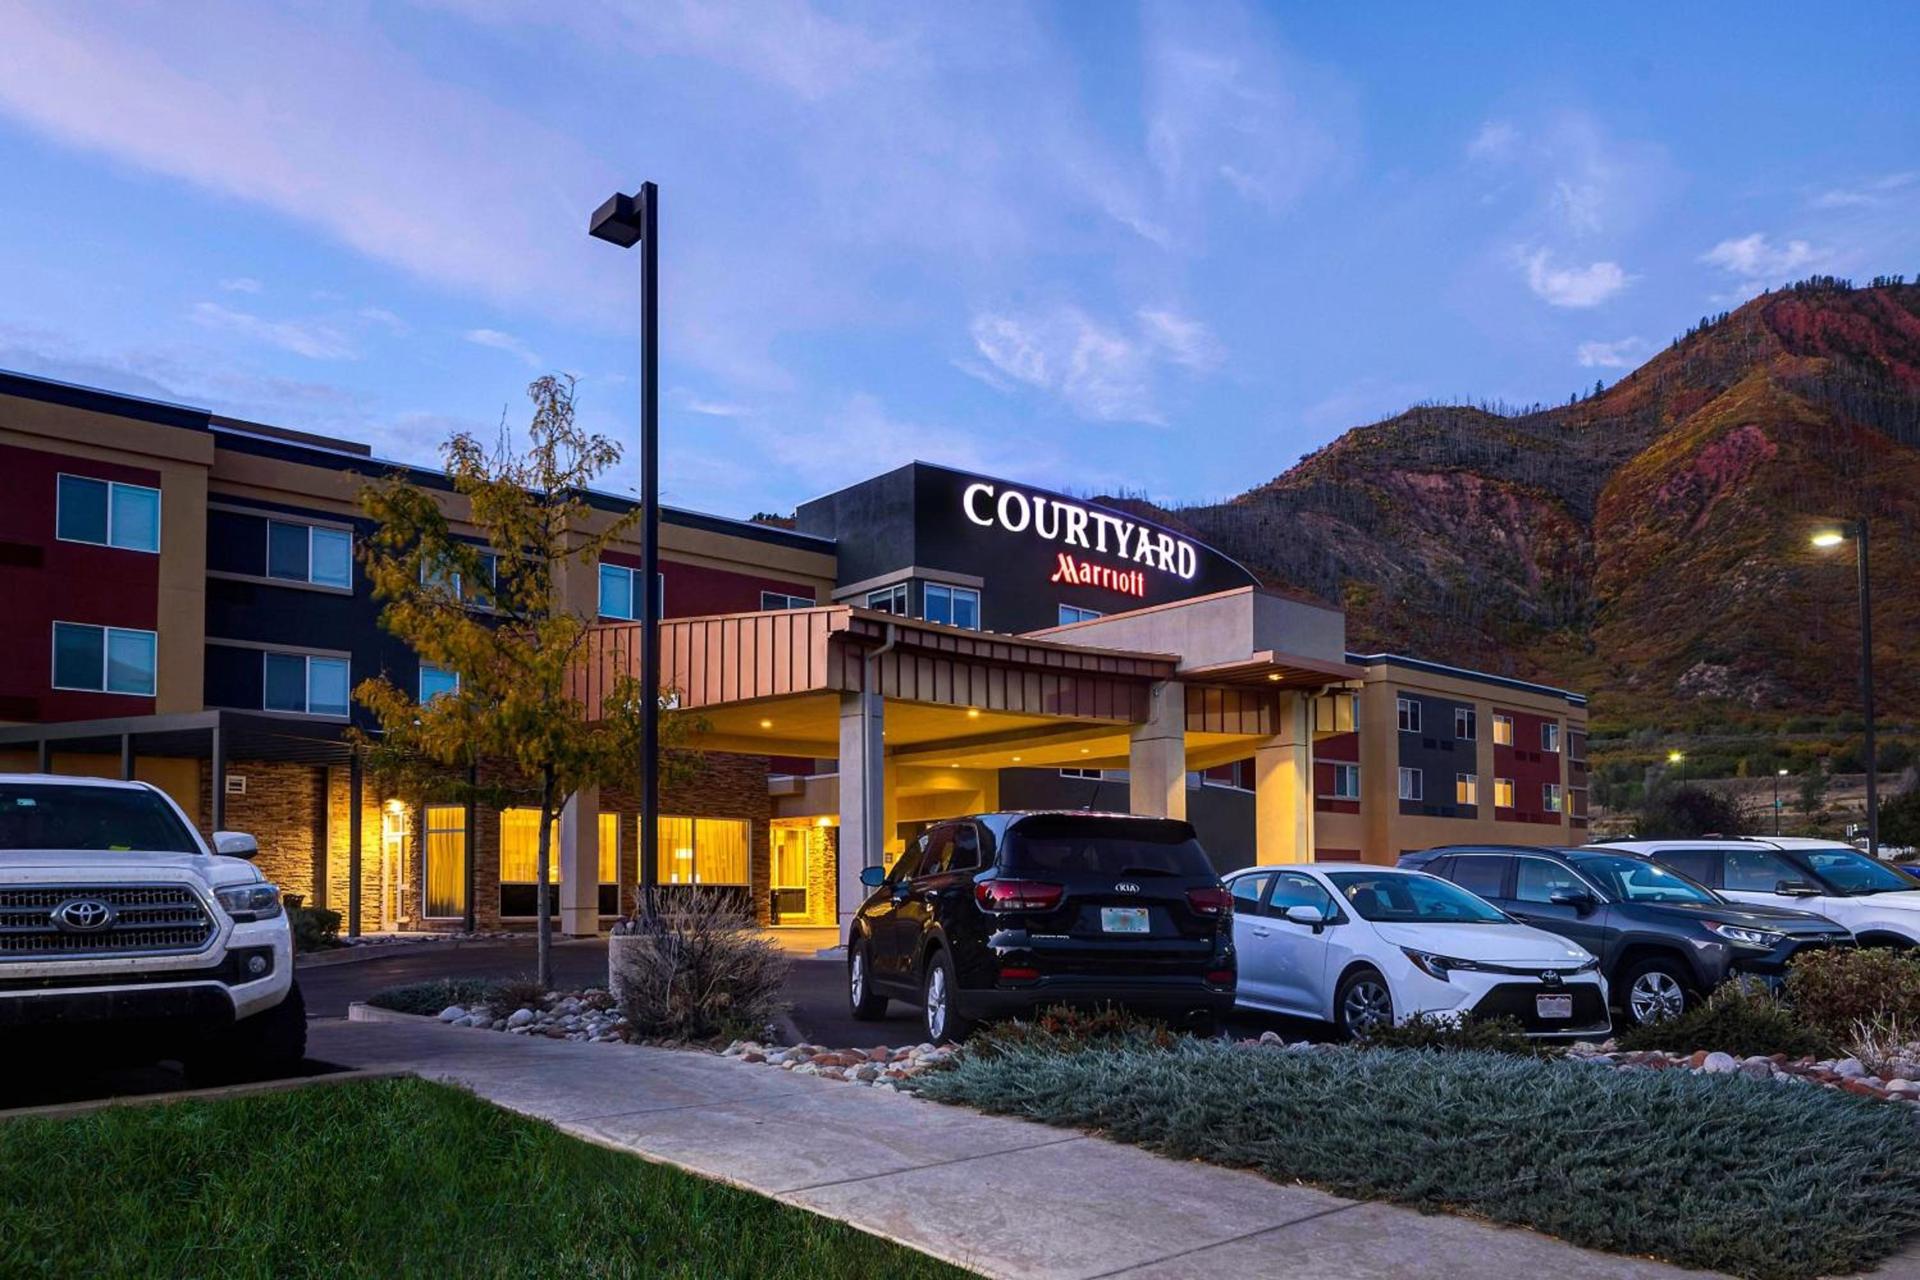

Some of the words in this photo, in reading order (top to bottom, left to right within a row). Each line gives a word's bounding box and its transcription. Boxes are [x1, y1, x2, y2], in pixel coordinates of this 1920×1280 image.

[963, 483, 1197, 580] COURTYARD
[1051, 552, 1145, 597] Marriott
[1119, 883, 1136, 892] KIA
